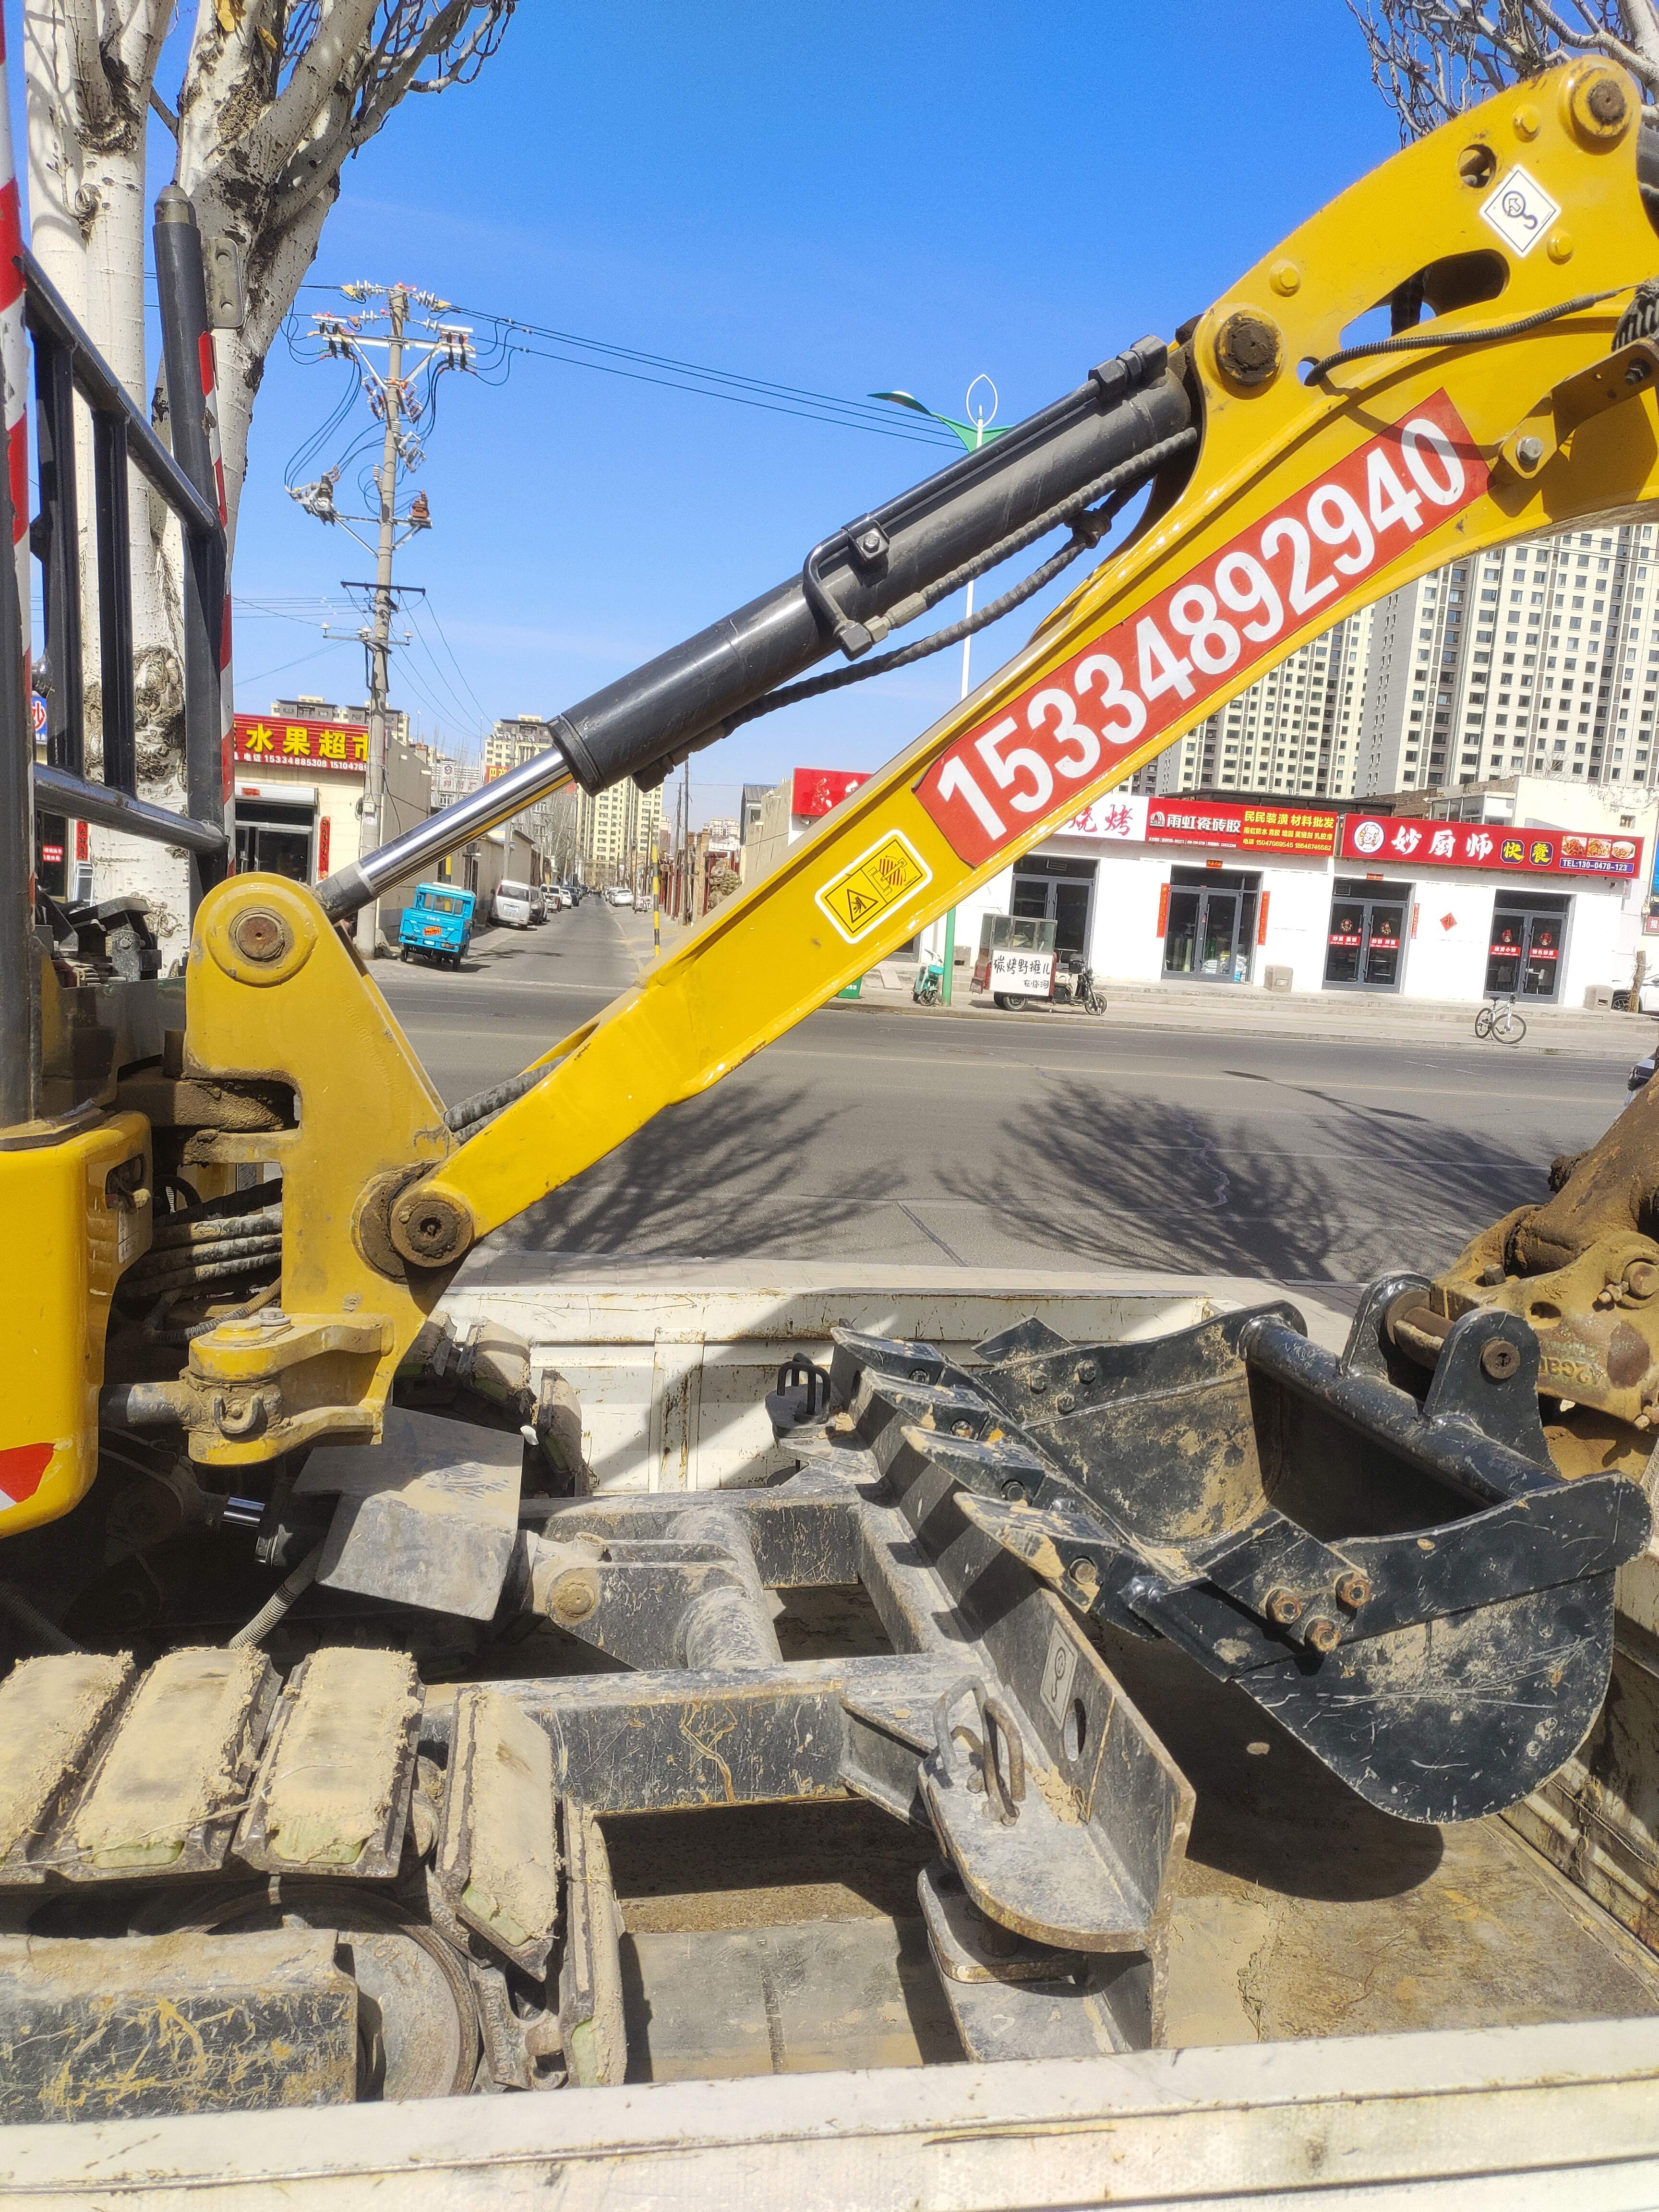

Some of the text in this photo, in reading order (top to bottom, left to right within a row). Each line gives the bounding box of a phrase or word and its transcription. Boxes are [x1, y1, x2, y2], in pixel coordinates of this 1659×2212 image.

[937, 418, 1466, 841] 15334892940
[234, 723, 368, 762] 水果超市
[244, 753, 262, 762] 电话
[1167, 814, 1241, 833] 雨虹瓷砖胶
[1244, 811, 1335, 829] 民民装潢 材料批发
[1243, 827, 1267, 835] 雨虹防水
[1391, 825, 1552, 863] 妙厨师 快餐
